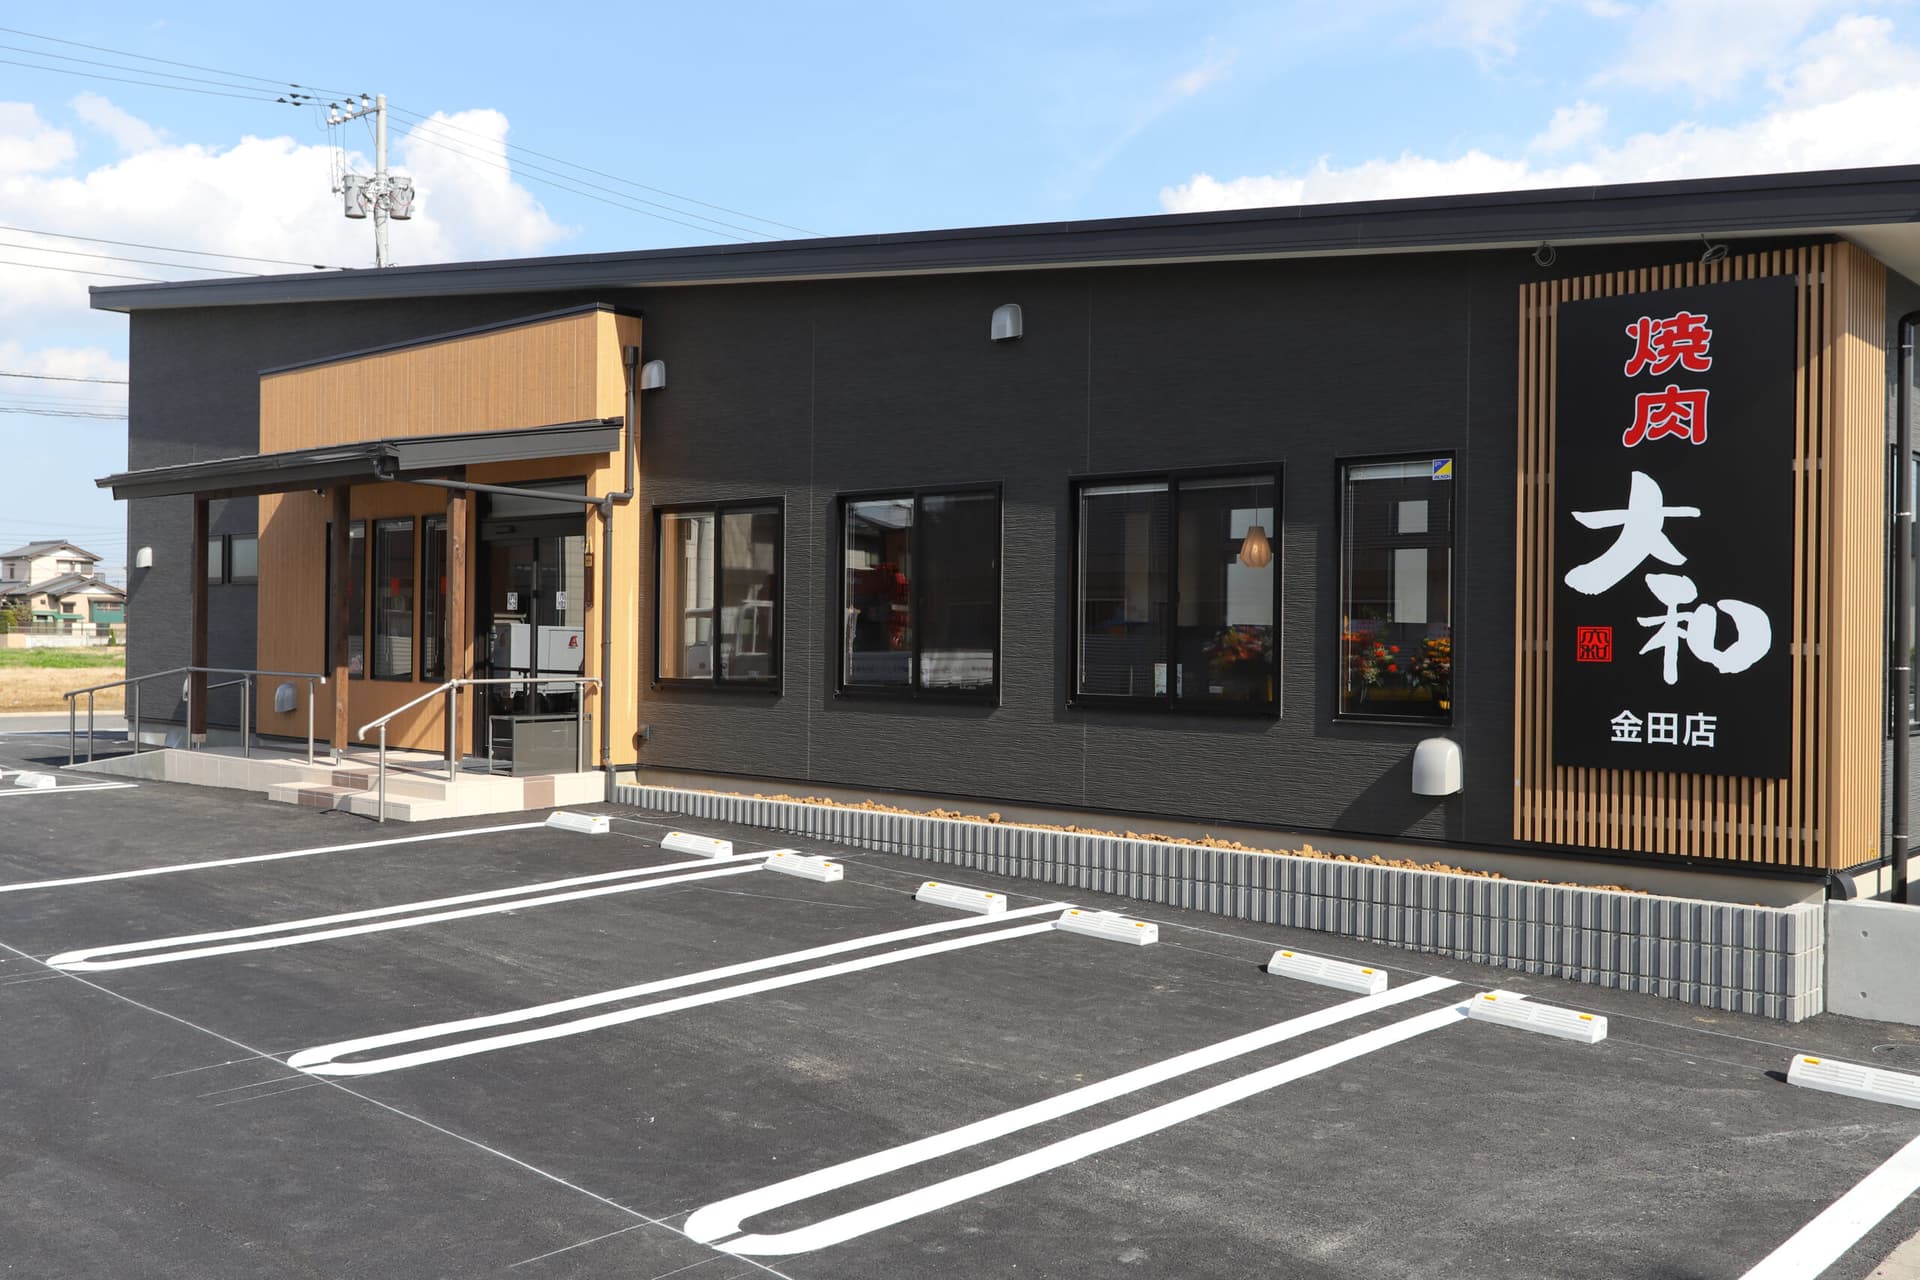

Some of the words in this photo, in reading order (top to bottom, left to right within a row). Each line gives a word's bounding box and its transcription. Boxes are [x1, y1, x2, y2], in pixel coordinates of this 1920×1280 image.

[1623, 311, 1712, 447] 焼肉
[1565, 471, 1771, 685] 大和
[1611, 710, 1717, 747] 金田店
